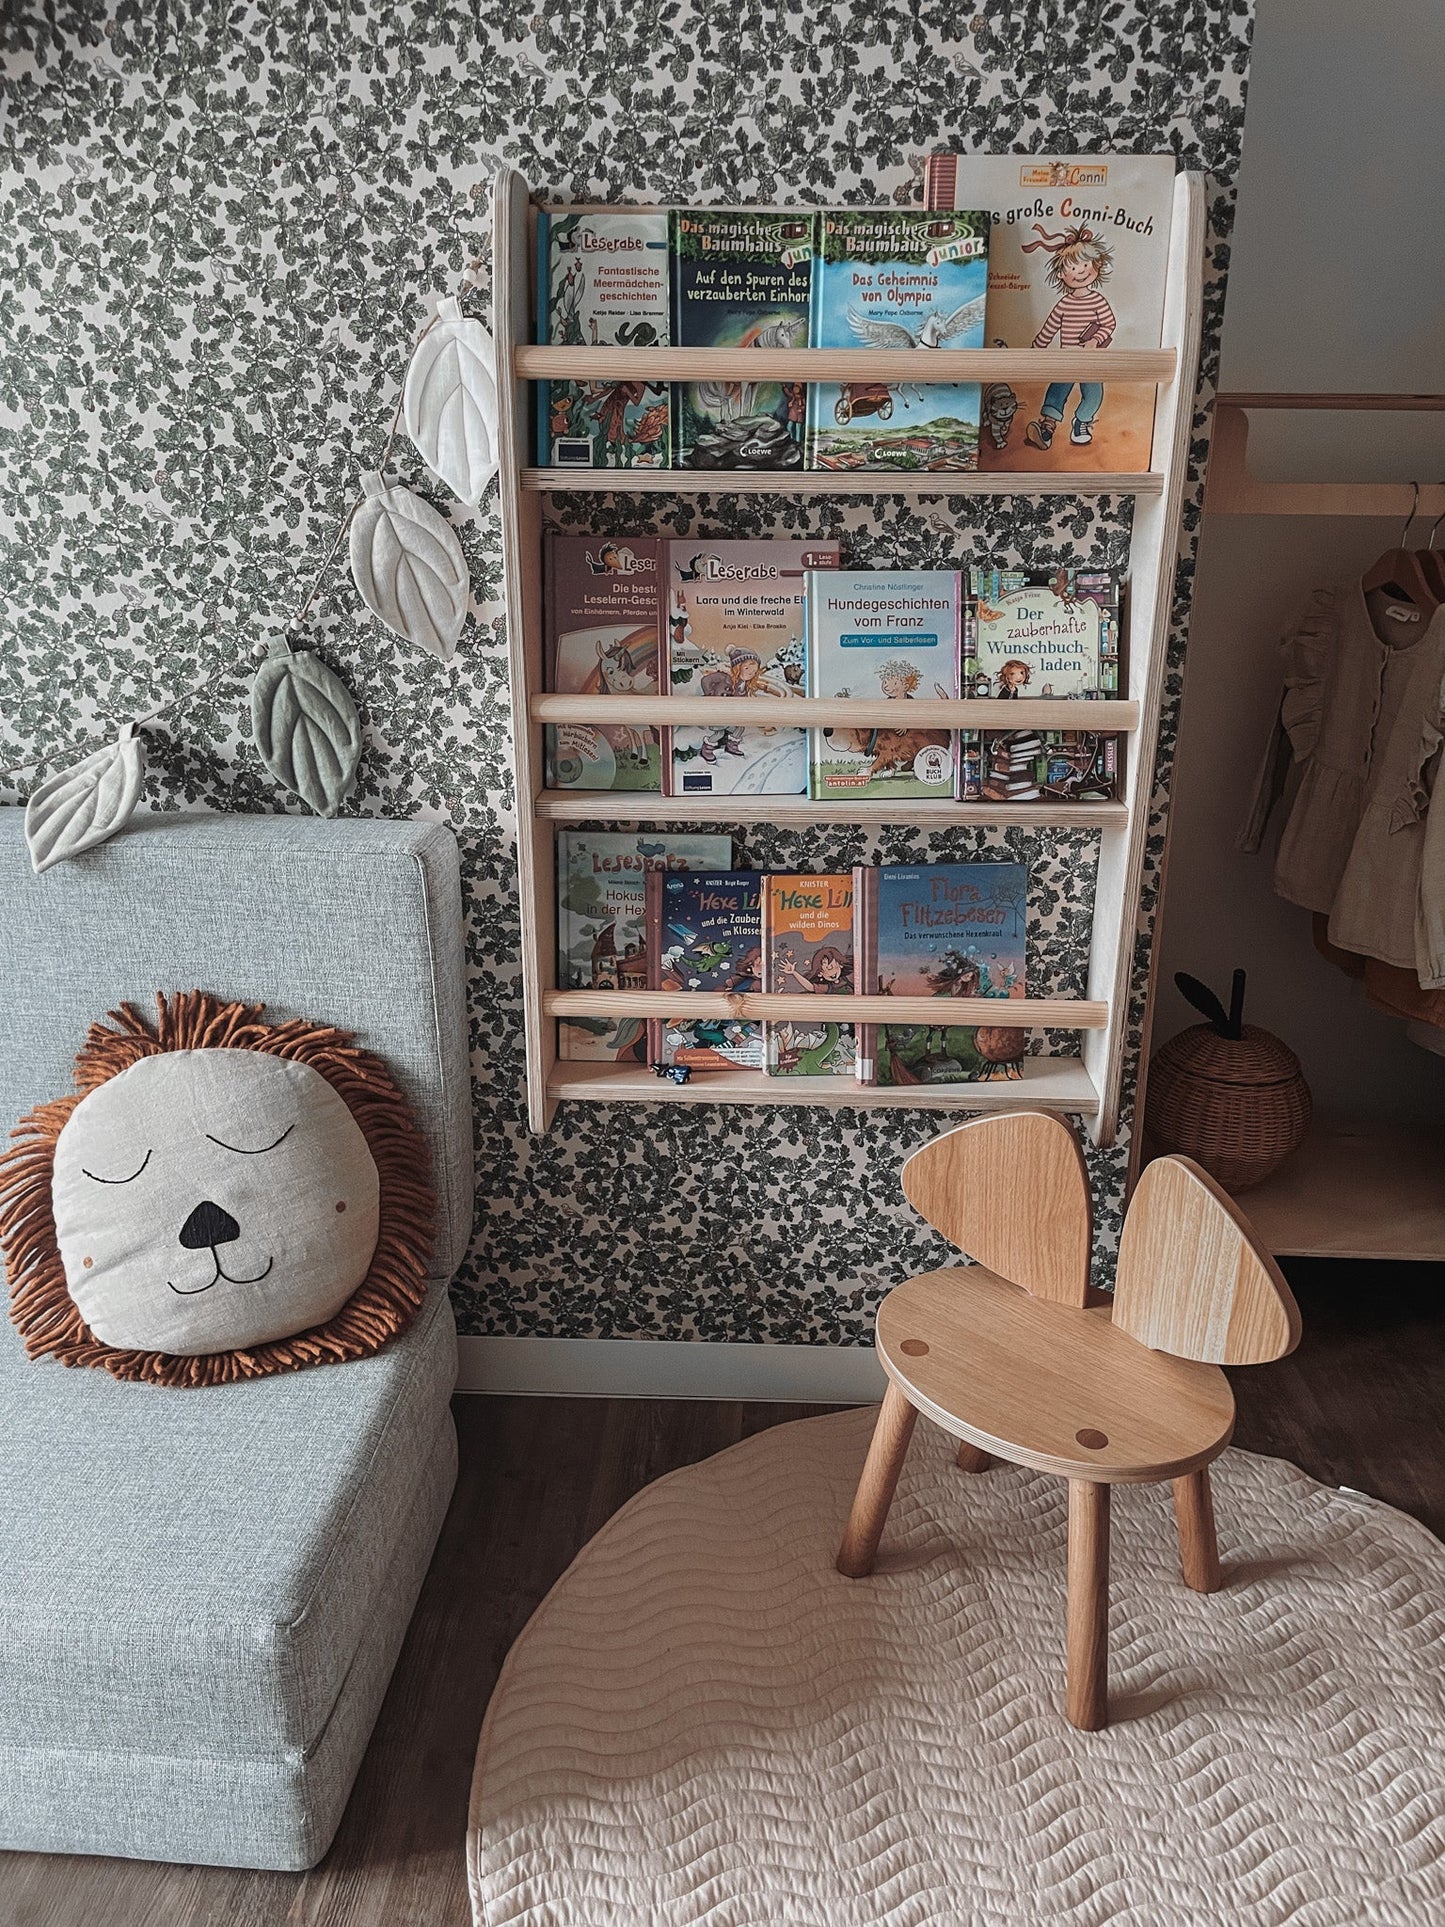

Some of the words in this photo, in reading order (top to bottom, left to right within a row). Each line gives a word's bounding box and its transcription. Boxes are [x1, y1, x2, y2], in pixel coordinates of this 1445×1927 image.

[1070, 167, 1105, 185] Conni
[1006, 199, 1054, 225] große
[1060, 197, 1154, 236] Conni-Buch
[681, 219, 705, 233] Das
[709, 221, 772, 238] magische
[826, 221, 850, 235] Das
[853, 220, 919, 238] magische
[584, 233, 642, 250] Leserabe
[702, 235, 781, 252] Baumhaus
[846, 235, 929, 252] Baumhaus
[931, 240, 981, 266] junior
[598, 266, 660, 276] Fantastische
[852, 272, 873, 286] Das
[877, 270, 938, 286] Geheimnis
[593, 279, 664, 288] Meermädchen-
[695, 270, 717, 284] Auf
[720, 270, 742, 284] den
[746, 272, 784, 290] Spuren
[788, 272, 808, 287] des
[600, 292, 657, 302] geschichten
[687, 286, 766, 301] verzauberten
[861, 290, 882, 302] von
[887, 288, 932, 306] Olympia
[806, 553, 818, 565] 1.
[709, 560, 777, 580] Leserabe
[612, 583, 629, 593] Die
[853, 583, 886, 591] Christine
[696, 596, 719, 604] Lara
[721, 596, 740, 604] und
[742, 596, 758, 604] die
[760, 596, 791, 604] freche
[828, 598, 950, 612] Hundegeschichten
[737, 608, 785, 616] Winterwald
[1016, 608, 1044, 620] Der
[854, 617, 882, 627] vom
[886, 615, 924, 627] Franz
[1007, 617, 1087, 639] zauberhafte
[842, 636, 859, 644] Zum
[877, 636, 892, 644] und
[987, 640, 1089, 654] Wunschbuch-
[1040, 658, 1081, 671] laden
[592, 852, 690, 873] Lesespatz
[666, 882, 684, 890] Arena
[928, 876, 981, 902] Flora
[606, 890, 645, 901] Hokus
[587, 905, 598, 914] in
[601, 905, 622, 915] der
[799, 911, 815, 919] und
[816, 911, 829, 919] die
[899, 901, 1007, 928] Flitzebesen
[701, 917, 715, 927] und
[716, 916, 728, 925] die
[729, 913, 761, 924] Zauber
[789, 921, 816, 929] wilden
[722, 928, 732, 936] im
[904, 931, 917, 940] Das
[918, 931, 964, 940] verwunschene
[965, 929, 1003, 938] Hexenkraut
